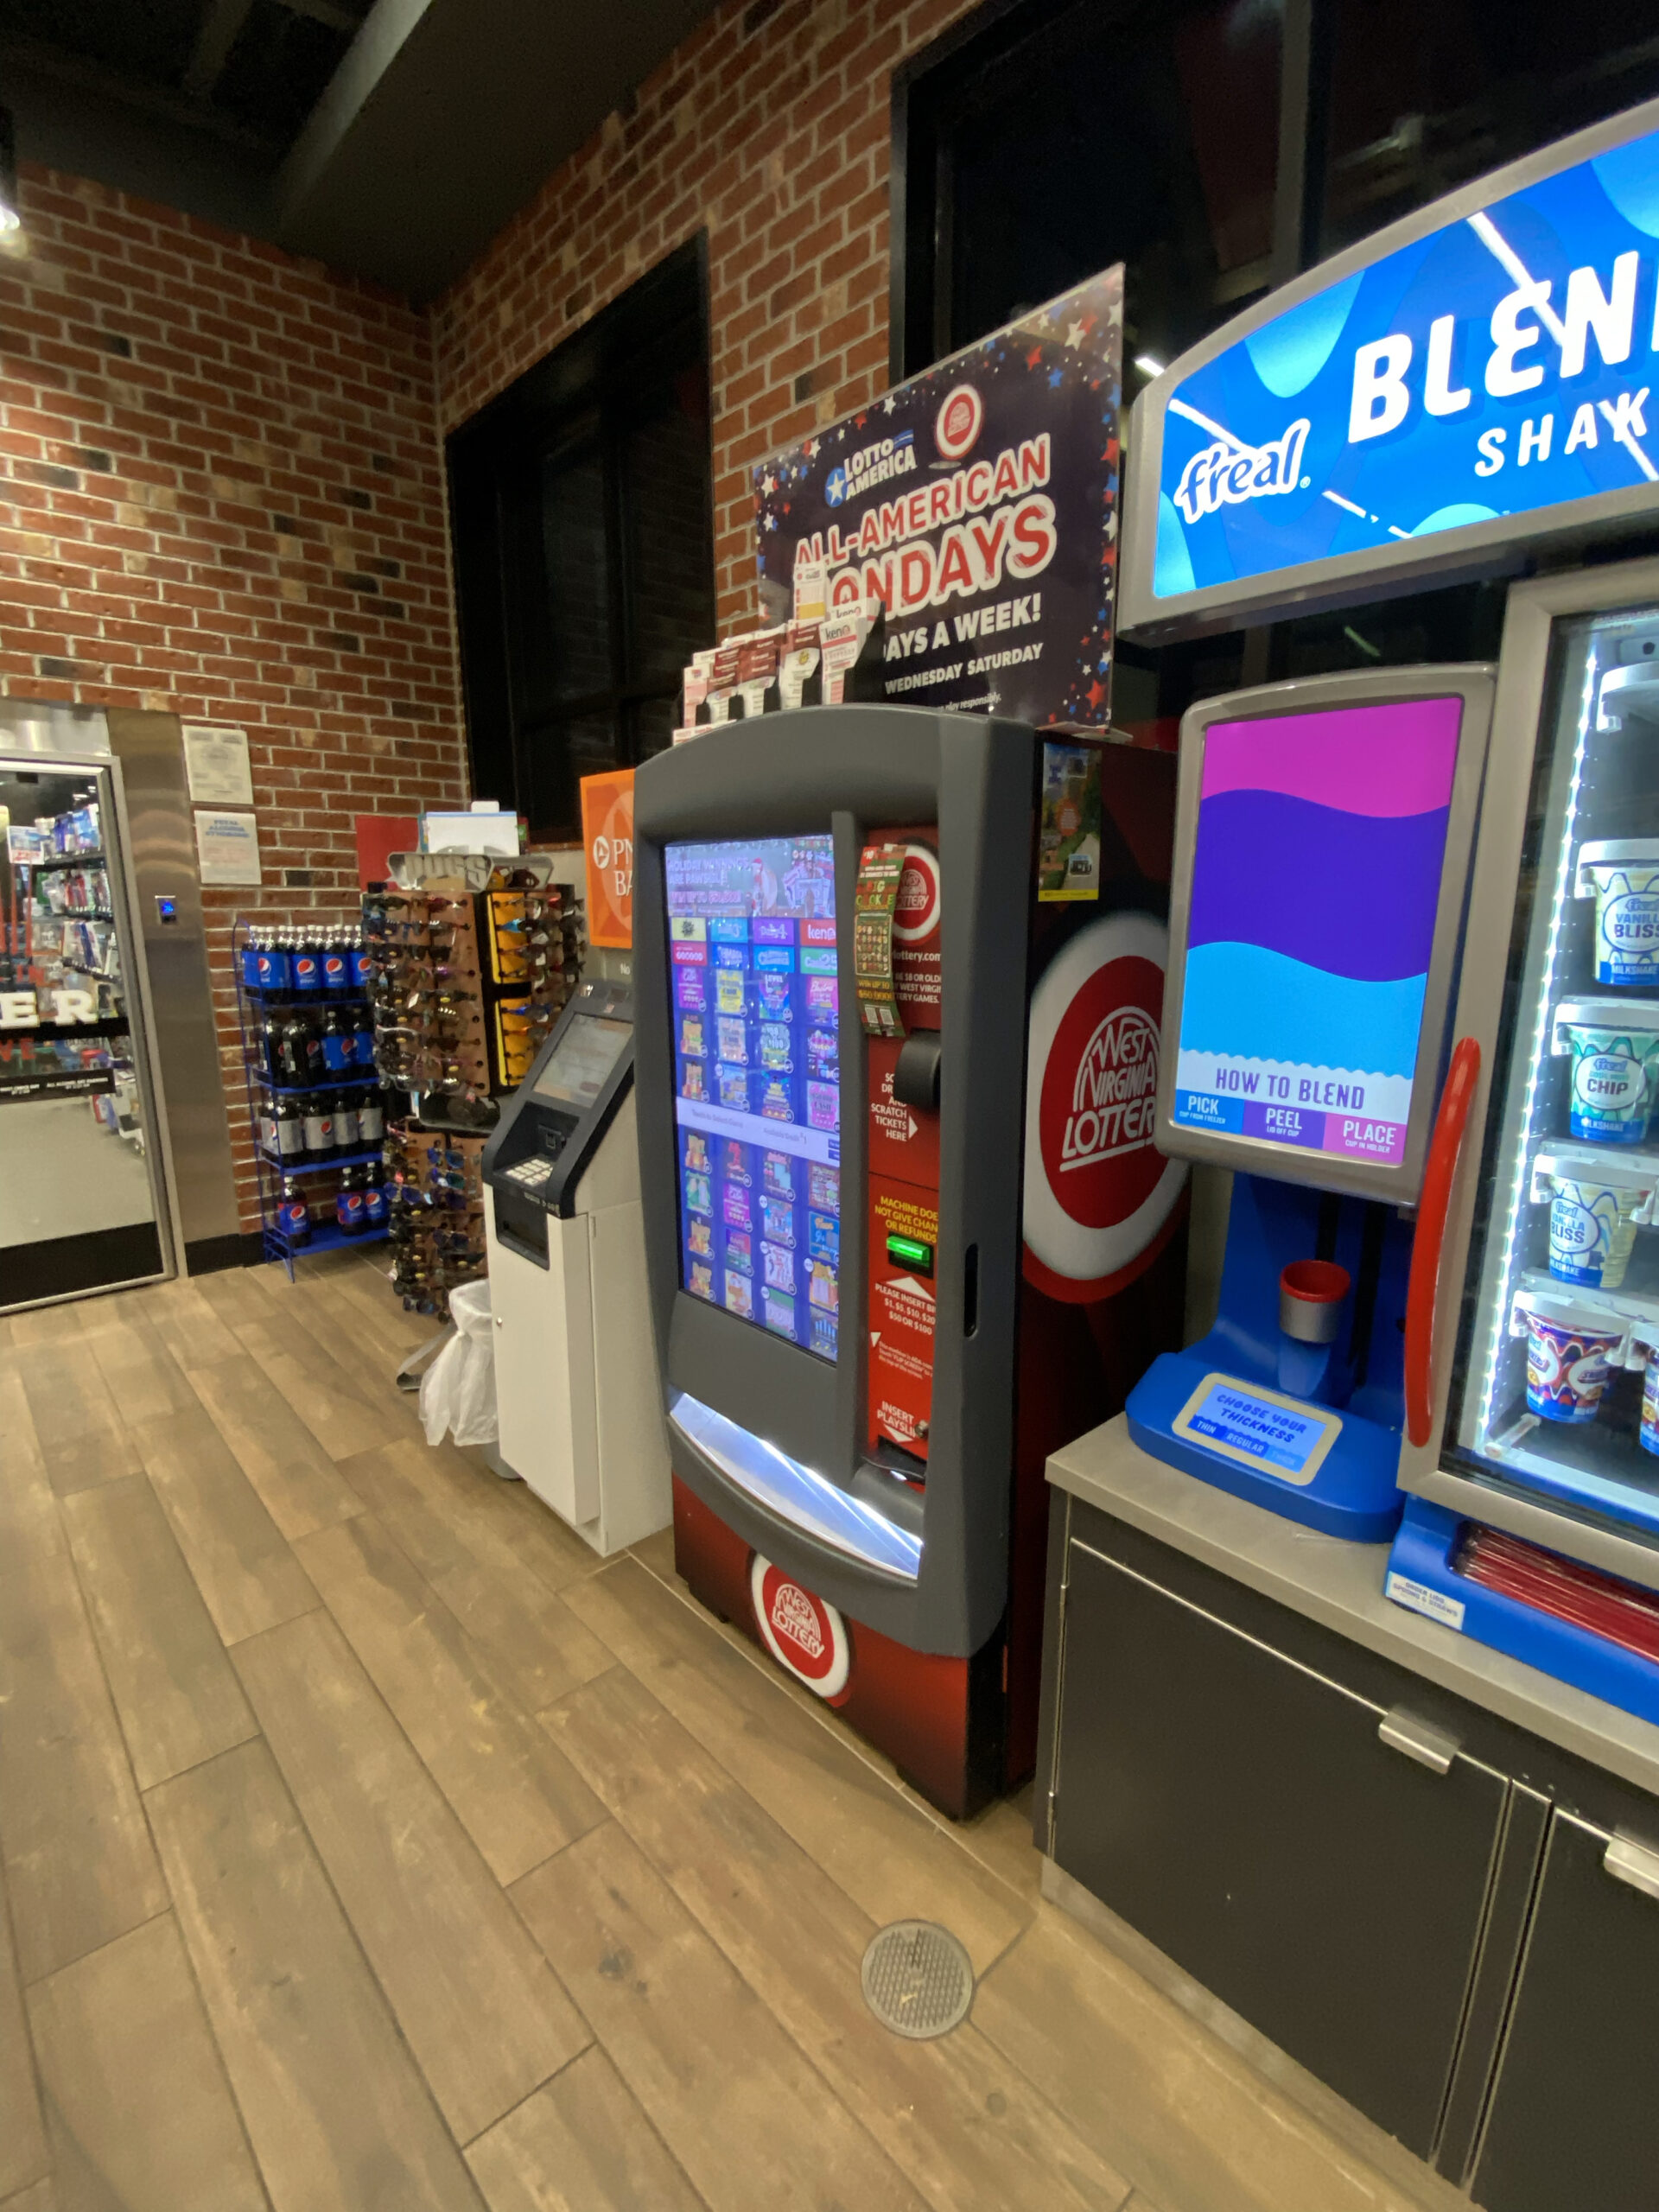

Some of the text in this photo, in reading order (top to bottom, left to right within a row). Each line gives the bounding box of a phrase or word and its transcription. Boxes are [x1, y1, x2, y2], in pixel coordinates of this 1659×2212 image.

[843, 437, 894, 480] LOTTO
[845, 444, 918, 501] AMERICA
[828, 494, 1058, 621] ONDAYS
[883, 592, 1042, 664] AYS A WEEK!
[885, 643, 1044, 695] WEDNESDAY SATURDAY
[1091, 1018, 1150, 1065] WEST
[1083, 1052, 1156, 1109] VIRGINIA
[1215, 1068, 1365, 1110] HOW TO BLEND
[1586, 1078, 1629, 1096] CHIP
[871, 1103, 907, 1119] SCRATCH
[874, 1115, 907, 1130] TICKETS
[1061, 1096, 1157, 1160] LOTTER
[1187, 1095, 1397, 1146] PICK PEEL PLACE
[886, 1128, 907, 1141] HERE
[1276, 1127, 1287, 1136] OFF
[874, 1205, 892, 1218] NOT
[892, 1209, 912, 1224] GIVE
[880, 1196, 918, 1216] MACHINE
[885, 1218, 938, 1243] OR REFUNDS
[874, 1282, 900, 1299] PLEASE
[901, 1291, 925, 1309] INSERT
[888, 1311, 932, 1335] $50 OR $100
[881, 1401, 914, 1425] INSERT
[1216, 1394, 1307, 1434] CHOOSE YOUR
[1219, 1408, 1296, 1444] THICKNESS
[1197, 1420, 1217, 1435] THIN
[1226, 1433, 1265, 1454] REGULAR
[772, 1605, 825, 1658] LOTTERY
